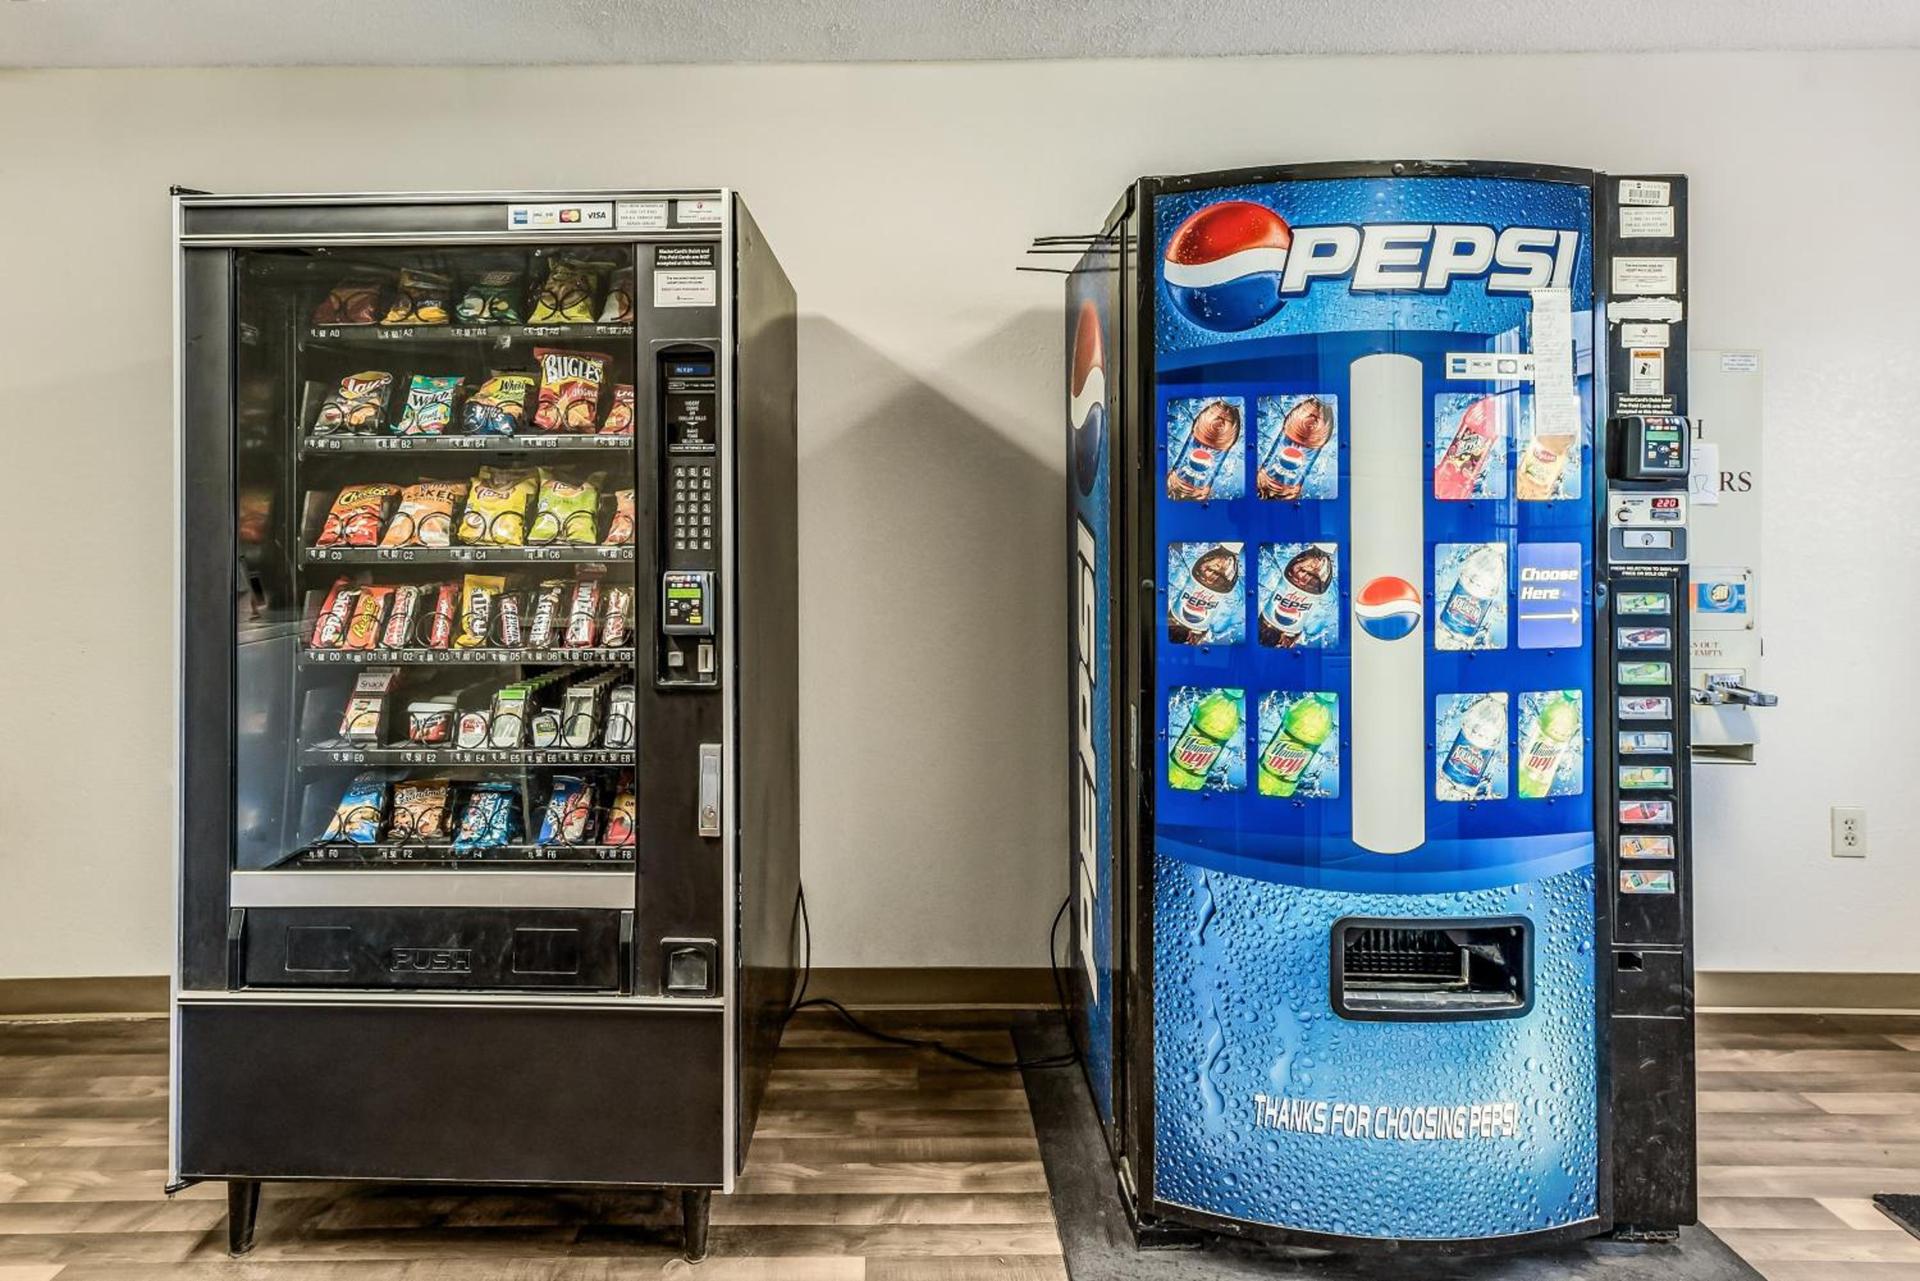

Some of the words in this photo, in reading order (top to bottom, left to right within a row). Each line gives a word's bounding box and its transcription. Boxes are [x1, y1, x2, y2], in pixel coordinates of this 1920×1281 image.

[587, 211, 606, 219] VISA
[1279, 225, 1579, 294] PEPSI
[545, 354, 602, 384] BUGLES
[1521, 567, 1578, 581] Choose
[1181, 592, 1219, 610] PEPSI
[1274, 593, 1312, 611] PEPSI
[1521, 586, 1560, 600] Here
[427, 754, 436, 762] E2
[1077, 516, 1098, 1007] PEPSI
[403, 850, 413, 858] F2
[393, 949, 471, 971] PUSH
[1255, 1095, 1328, 1135] THANKS
[1330, 1103, 1371, 1138] FOR
[1374, 1105, 1466, 1140] CHOOSING
[1469, 1102, 1518, 1139] PEPSI
